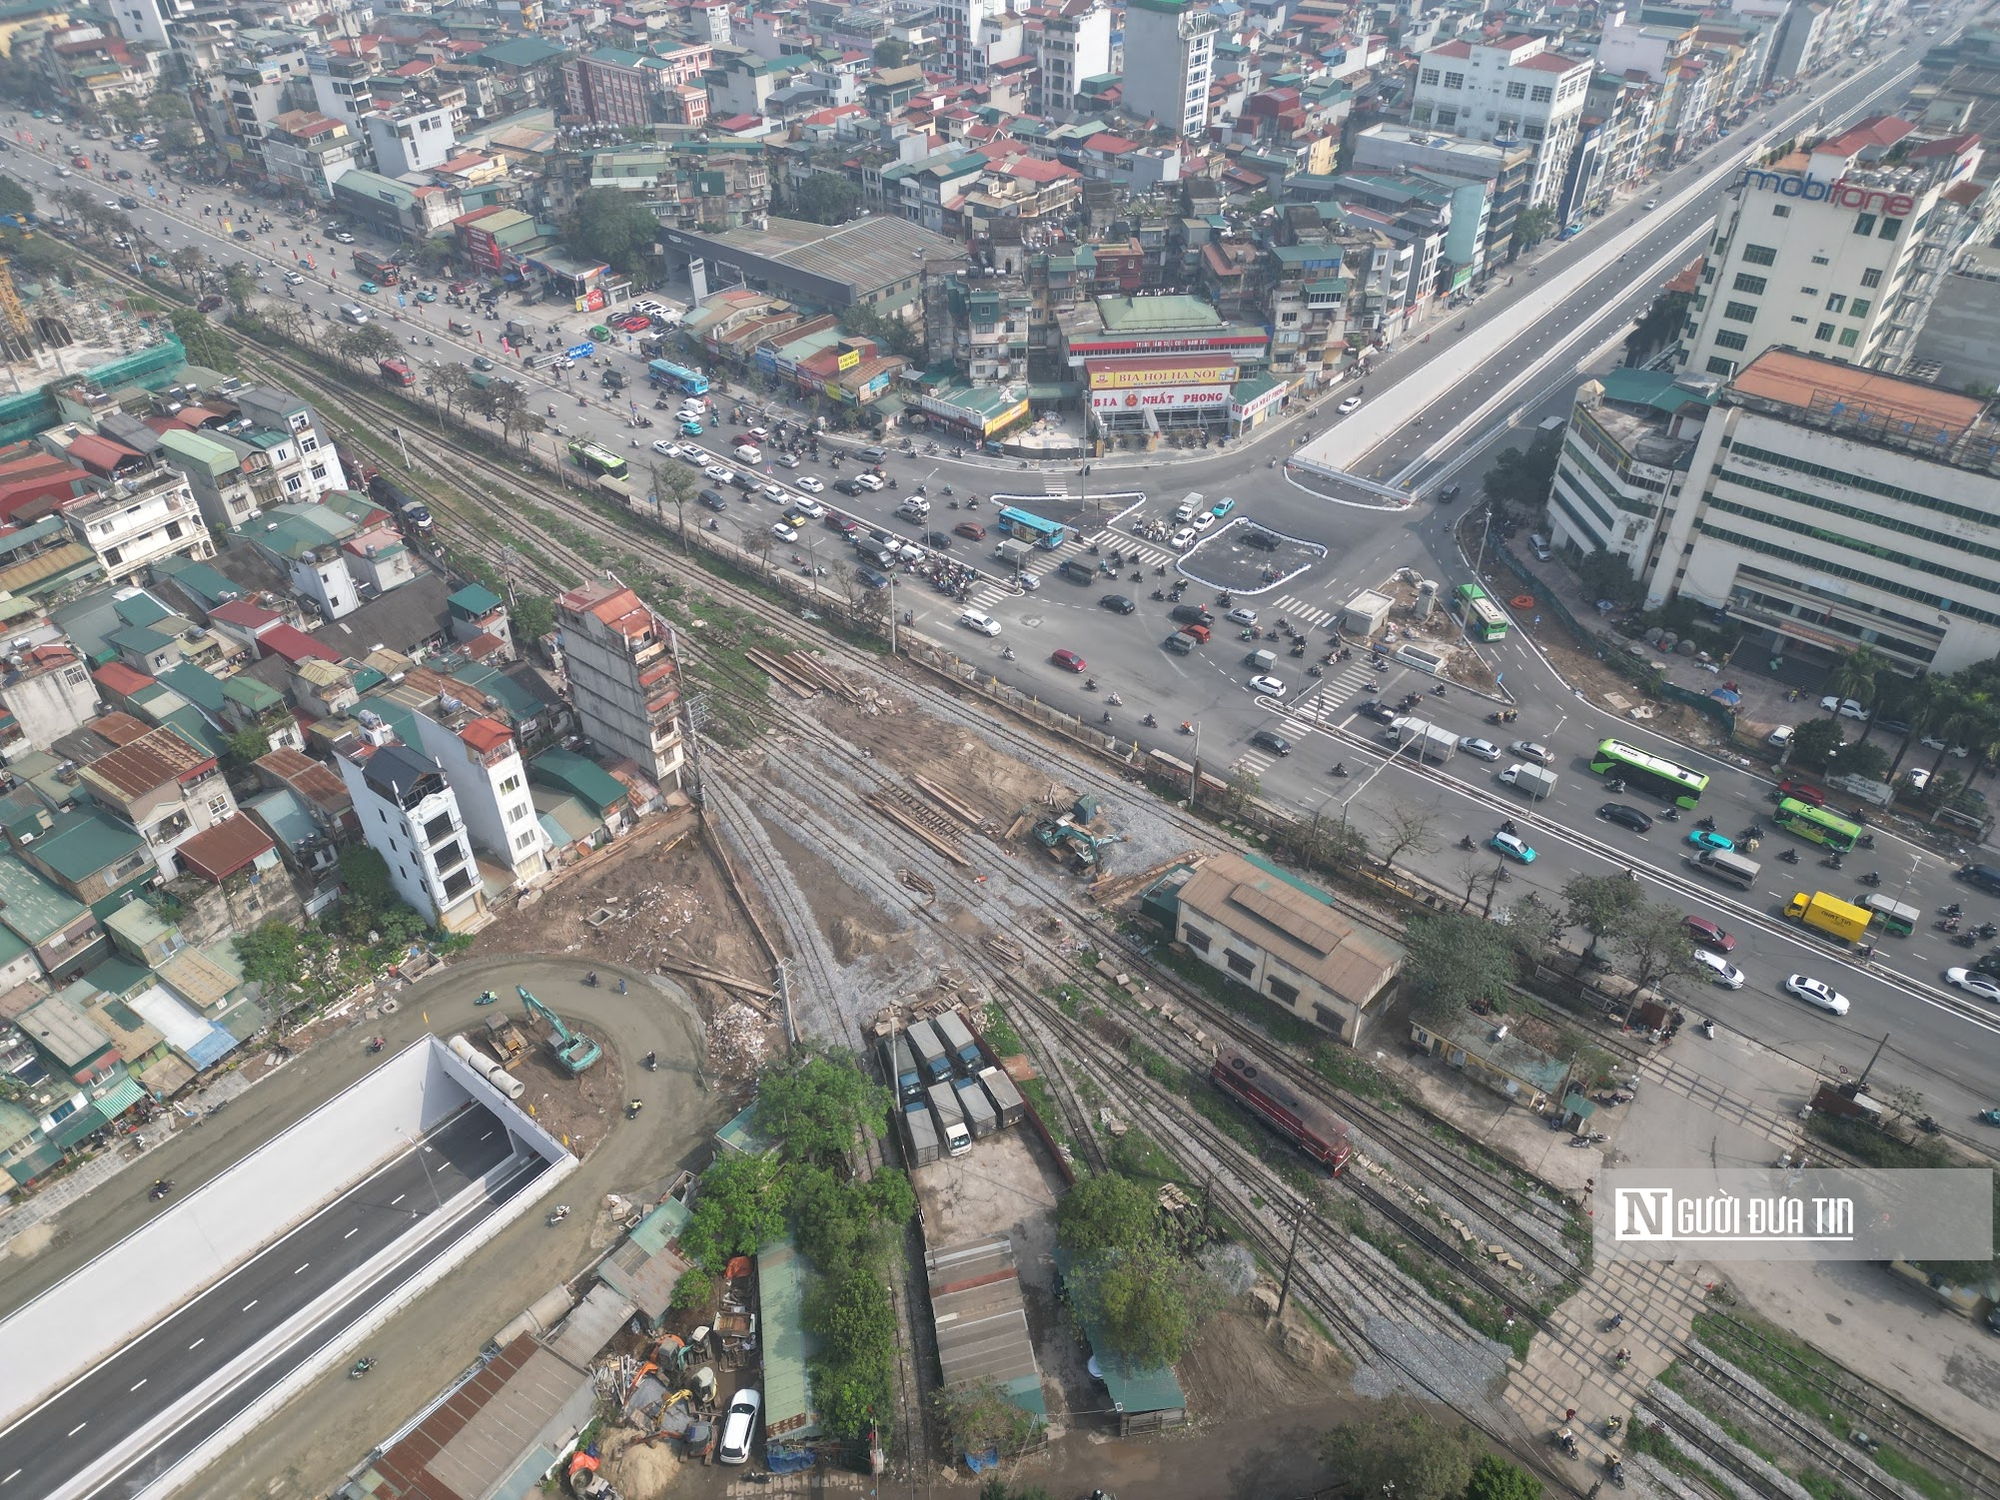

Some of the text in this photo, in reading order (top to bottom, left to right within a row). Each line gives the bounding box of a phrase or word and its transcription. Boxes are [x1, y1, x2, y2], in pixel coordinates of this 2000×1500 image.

[1742, 170, 1914, 216] mobifone
[1119, 374, 1139, 382] BIA
[1093, 391, 1223, 407] BIA NHẤT PHONG
